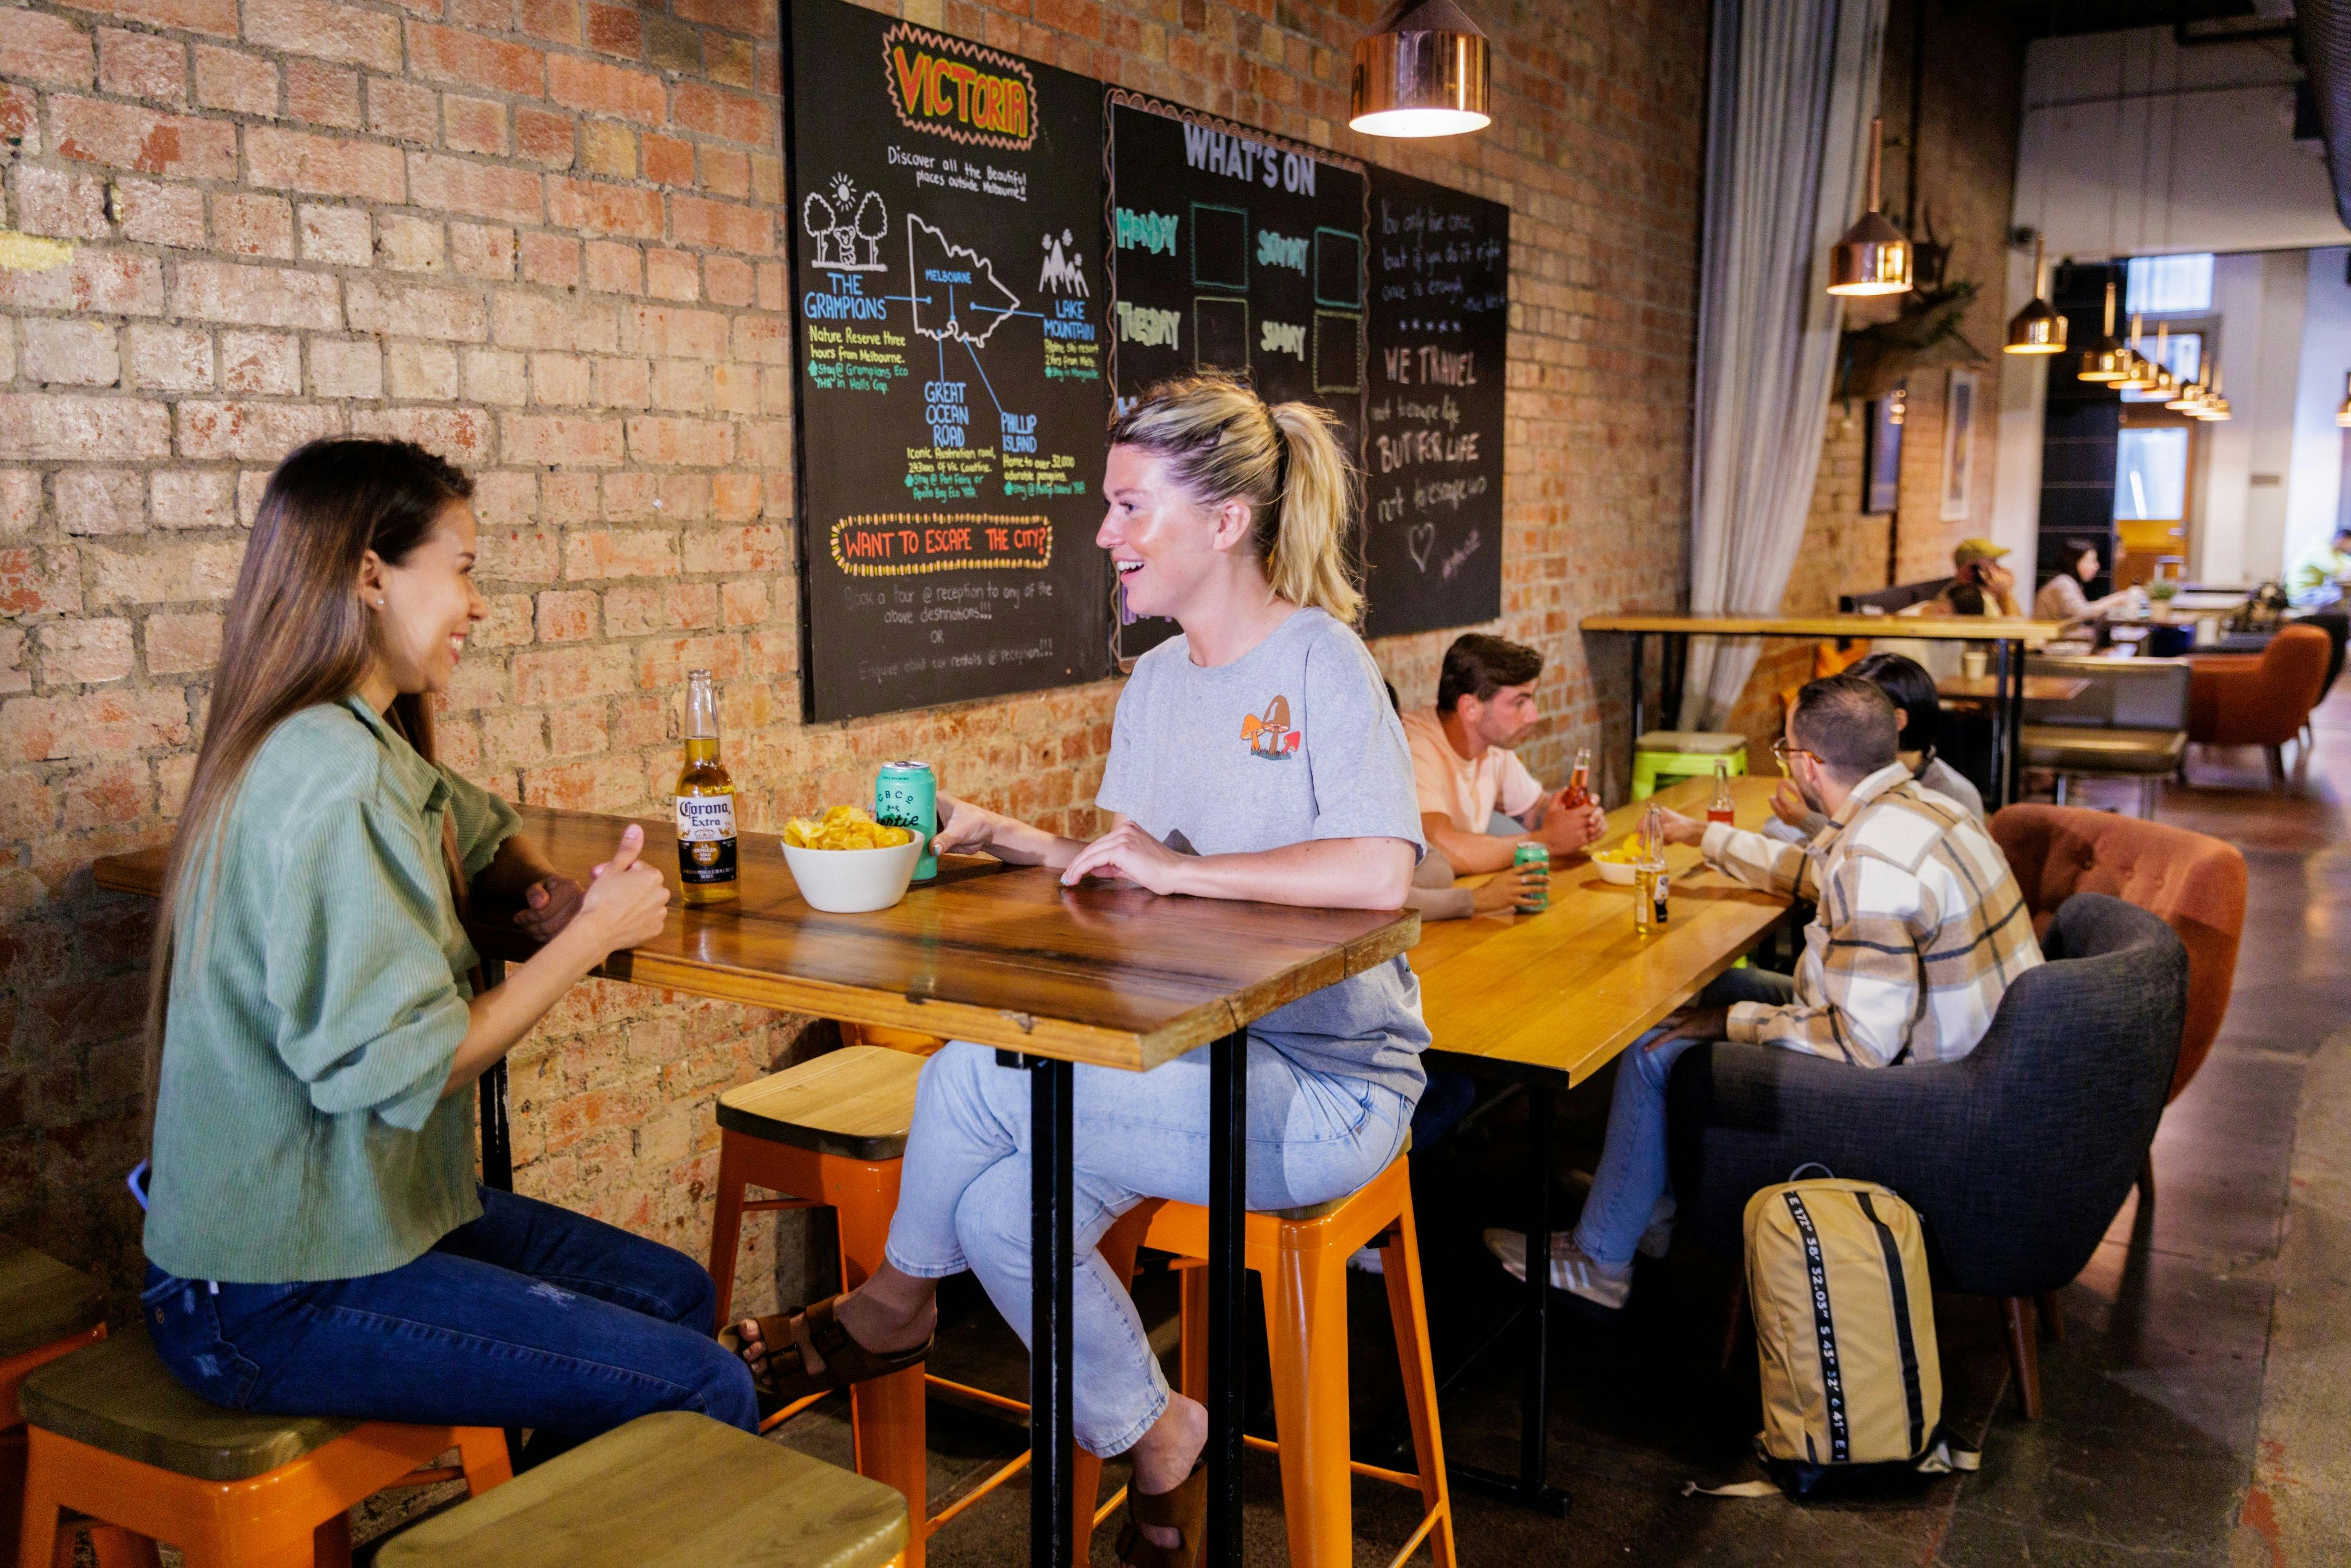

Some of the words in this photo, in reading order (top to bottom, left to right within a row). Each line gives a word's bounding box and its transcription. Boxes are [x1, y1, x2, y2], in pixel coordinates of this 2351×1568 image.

[894, 46, 1027, 138] VICTORIA
[888, 146, 936, 168] Discover
[942, 158, 957, 172] all
[964, 162, 982, 179] the
[1184, 122, 1278, 188] WHAT'S
[1283, 153, 1316, 197] ON
[916, 170, 945, 188] places
[948, 176, 979, 192] outside
[827, 272, 863, 296] THE
[925, 268, 972, 285] MELBOURNE
[1055, 300, 1085, 320] LAKE
[809, 325, 843, 343] Nature
[845, 327, 882, 344] Reserve
[883, 331, 906, 346] three
[1043, 319, 1095, 341] MOUNTAIN
[1117, 301, 1181, 351] TUESDAY
[810, 344, 836, 359] hours
[839, 346, 858, 361] from
[860, 350, 905, 363] Melbourne.
[845, 363, 891, 381] Grampians
[894, 364, 909, 377] Eco
[1384, 347, 1411, 385] WE
[1417, 345, 1477, 387] TRAVEL
[814, 377, 832, 389] YHA
[837, 378, 845, 389] in
[849, 378, 870, 390] Halls
[924, 381, 967, 403] GREAT
[926, 403, 969, 425] OCEAN
[1001, 411, 1037, 434] PHILLIP
[933, 424, 965, 448] ROAD
[1003, 434, 1037, 453] ISLAND
[906, 447, 933, 459] Iconic
[1377, 431, 1412, 473] BUT
[1417, 430, 1444, 464] FOR
[1445, 432, 1480, 461] LIFE
[844, 531, 895, 559] WANT
[898, 530, 918, 555] TO
[925, 527, 972, 554] ESCAPE
[984, 527, 1010, 552] THE
[1014, 527, 1047, 556] CITY?
[877, 592, 886, 605] a
[894, 584, 915, 603] tour
[922, 587, 933, 603] @
[936, 582, 984, 603] reception
[987, 581, 999, 597] to
[1003, 587, 1020, 609] any
[1023, 583, 1034, 598] of
[1038, 581, 1053, 597] the
[884, 609, 914, 624] above
[680, 801, 728, 819] Corona
[692, 816, 720, 826] Extra
[1789, 1197, 1799, 1205] E
[1820, 1326, 1831, 1334] S
[1836, 1440, 1846, 1449] E
